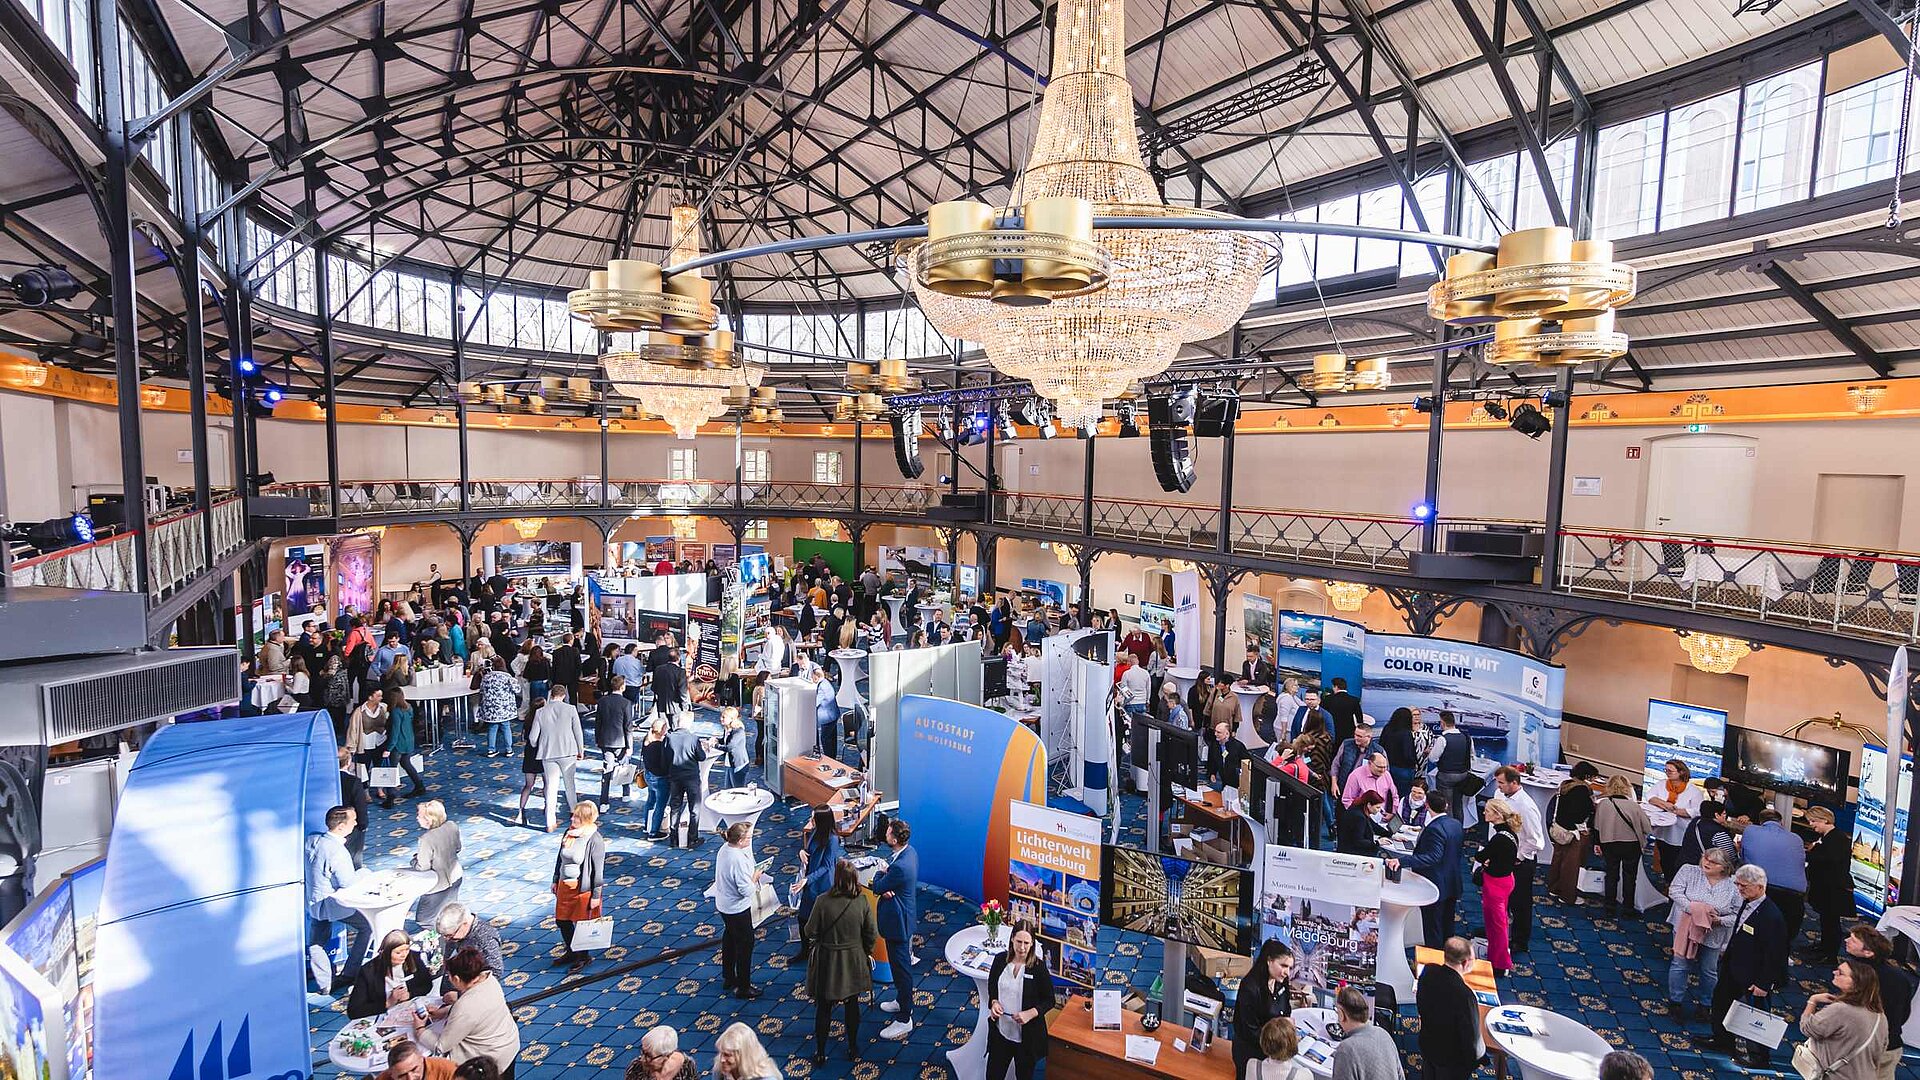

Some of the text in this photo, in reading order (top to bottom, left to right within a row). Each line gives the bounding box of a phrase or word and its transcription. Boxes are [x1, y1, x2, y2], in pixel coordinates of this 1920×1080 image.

[1383, 658, 1473, 680] COLOR LINE
[1384, 645, 1500, 673] NORWEGEN MIT
[915, 717, 976, 742] AUTOSTADT
[1017, 831, 1092, 861] Lichterwelt
[1020, 846, 1087, 875] Magdeburg
[1332, 858, 1358, 868] Germany
[1283, 926, 1359, 953] Magdeburg
